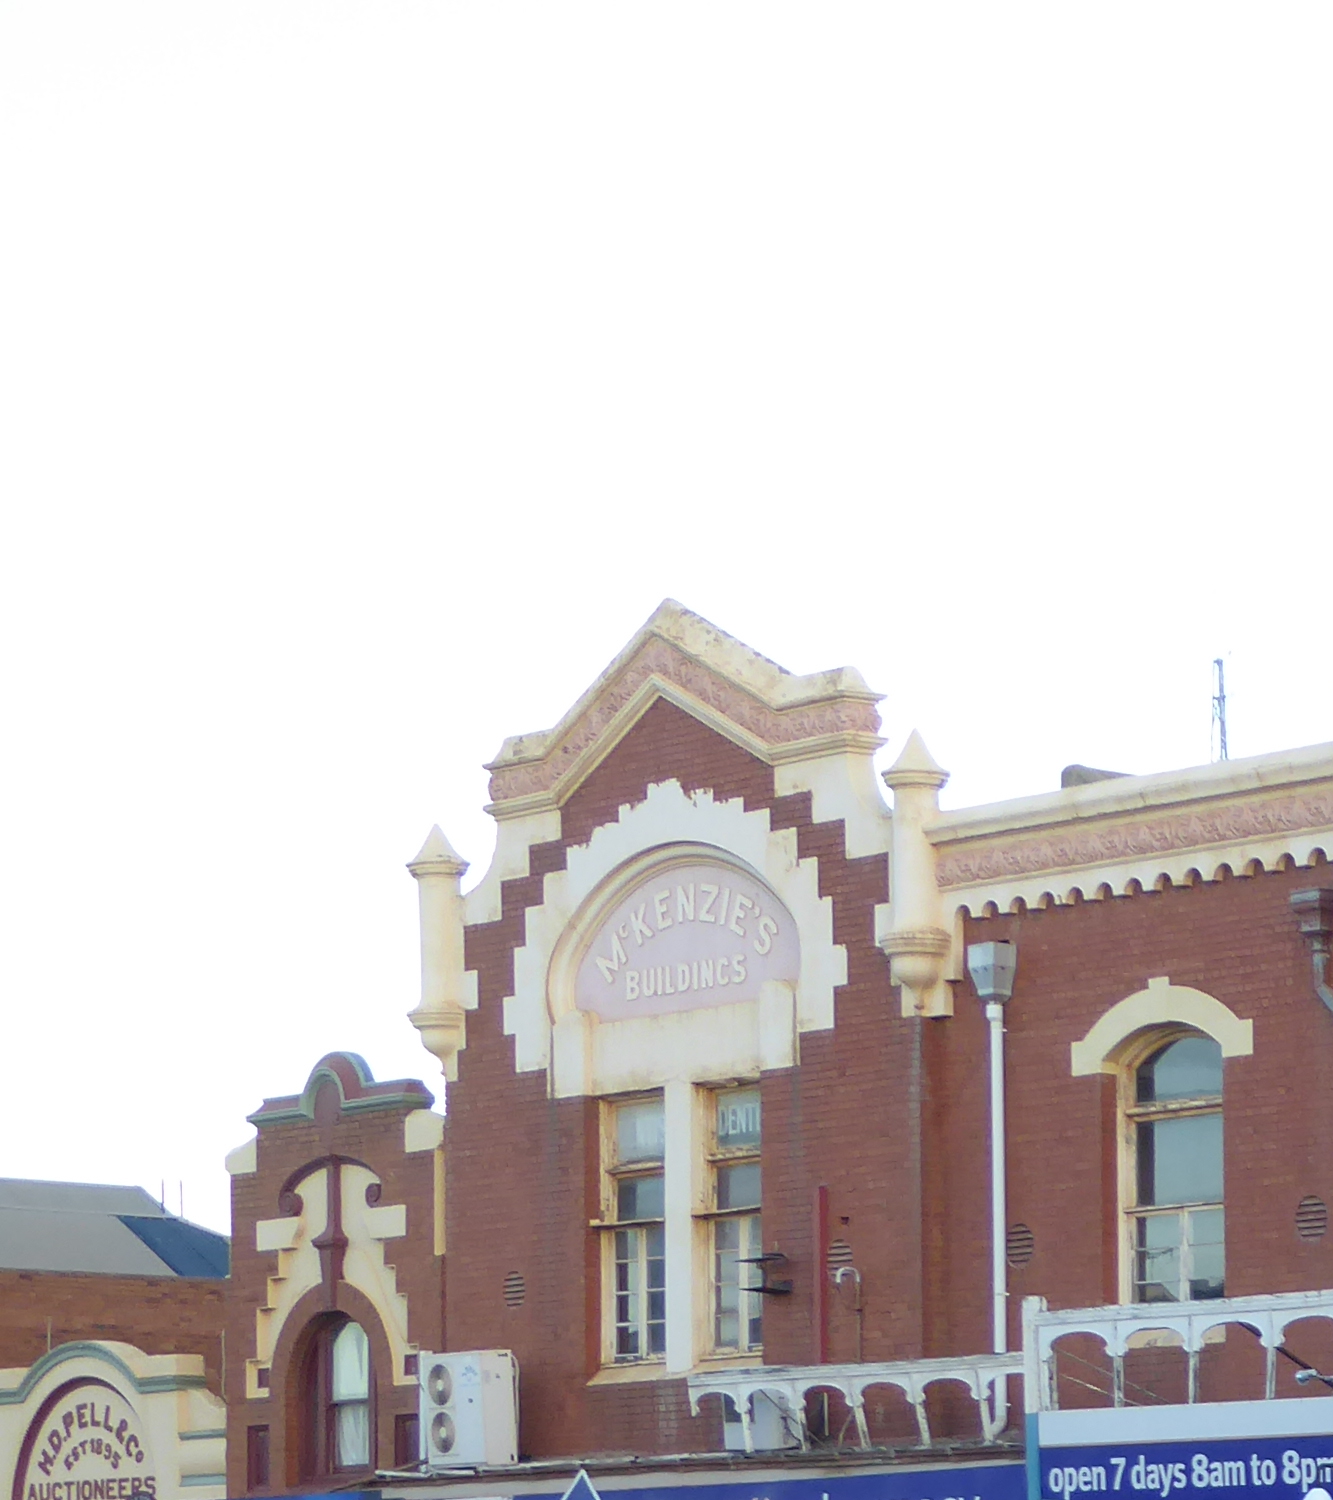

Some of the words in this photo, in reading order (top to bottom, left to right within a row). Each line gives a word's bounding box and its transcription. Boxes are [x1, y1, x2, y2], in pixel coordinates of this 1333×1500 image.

[625, 954, 748, 1001] BUILDINGS
[1050, 1466, 1106, 1500] open
[1110, 1457, 1126, 1490] 7
[1131, 1455, 1186, 1497] days
[1191, 1454, 1246, 1487] 8am
[1251, 1454, 1275, 1485] to
